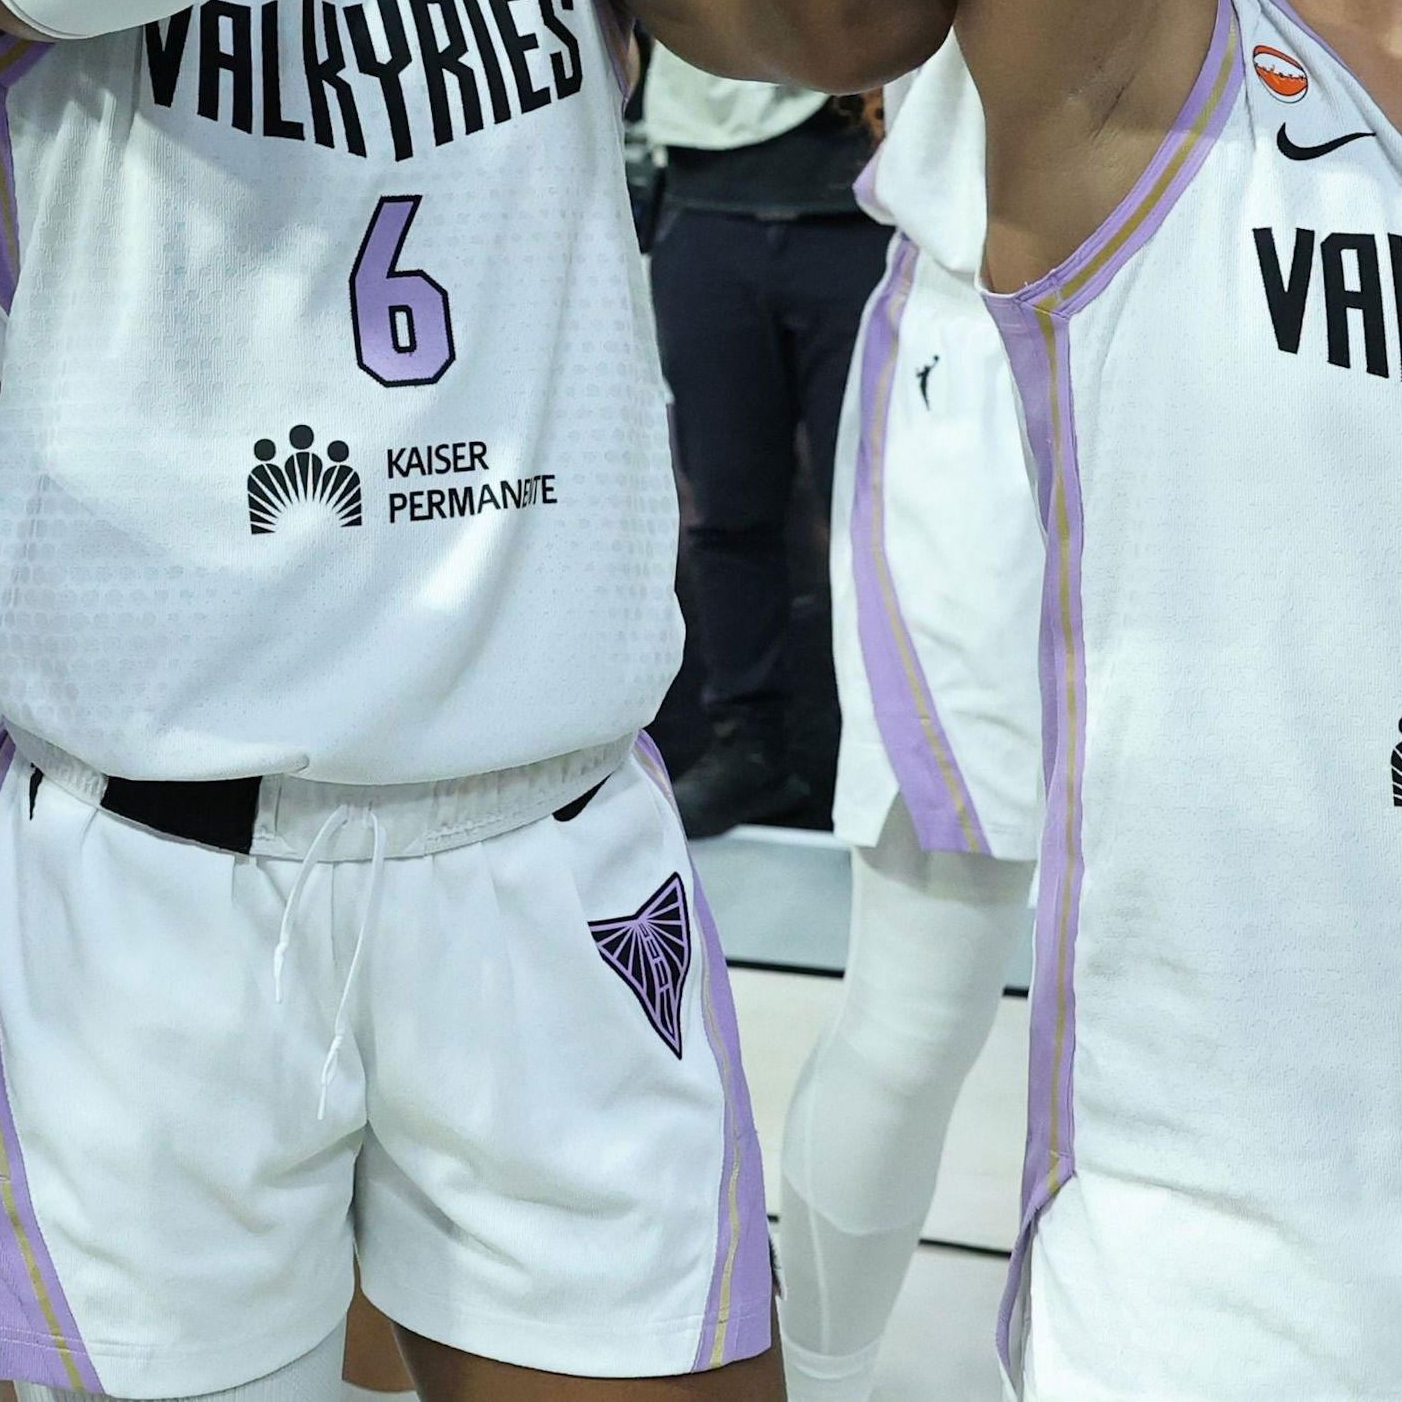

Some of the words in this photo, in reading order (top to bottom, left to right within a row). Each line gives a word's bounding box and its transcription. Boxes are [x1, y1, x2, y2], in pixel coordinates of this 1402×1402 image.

[349, 195, 456, 388] 6
[387, 441, 489, 479] KAISER
[388, 474, 558, 524] PERMANENTE
